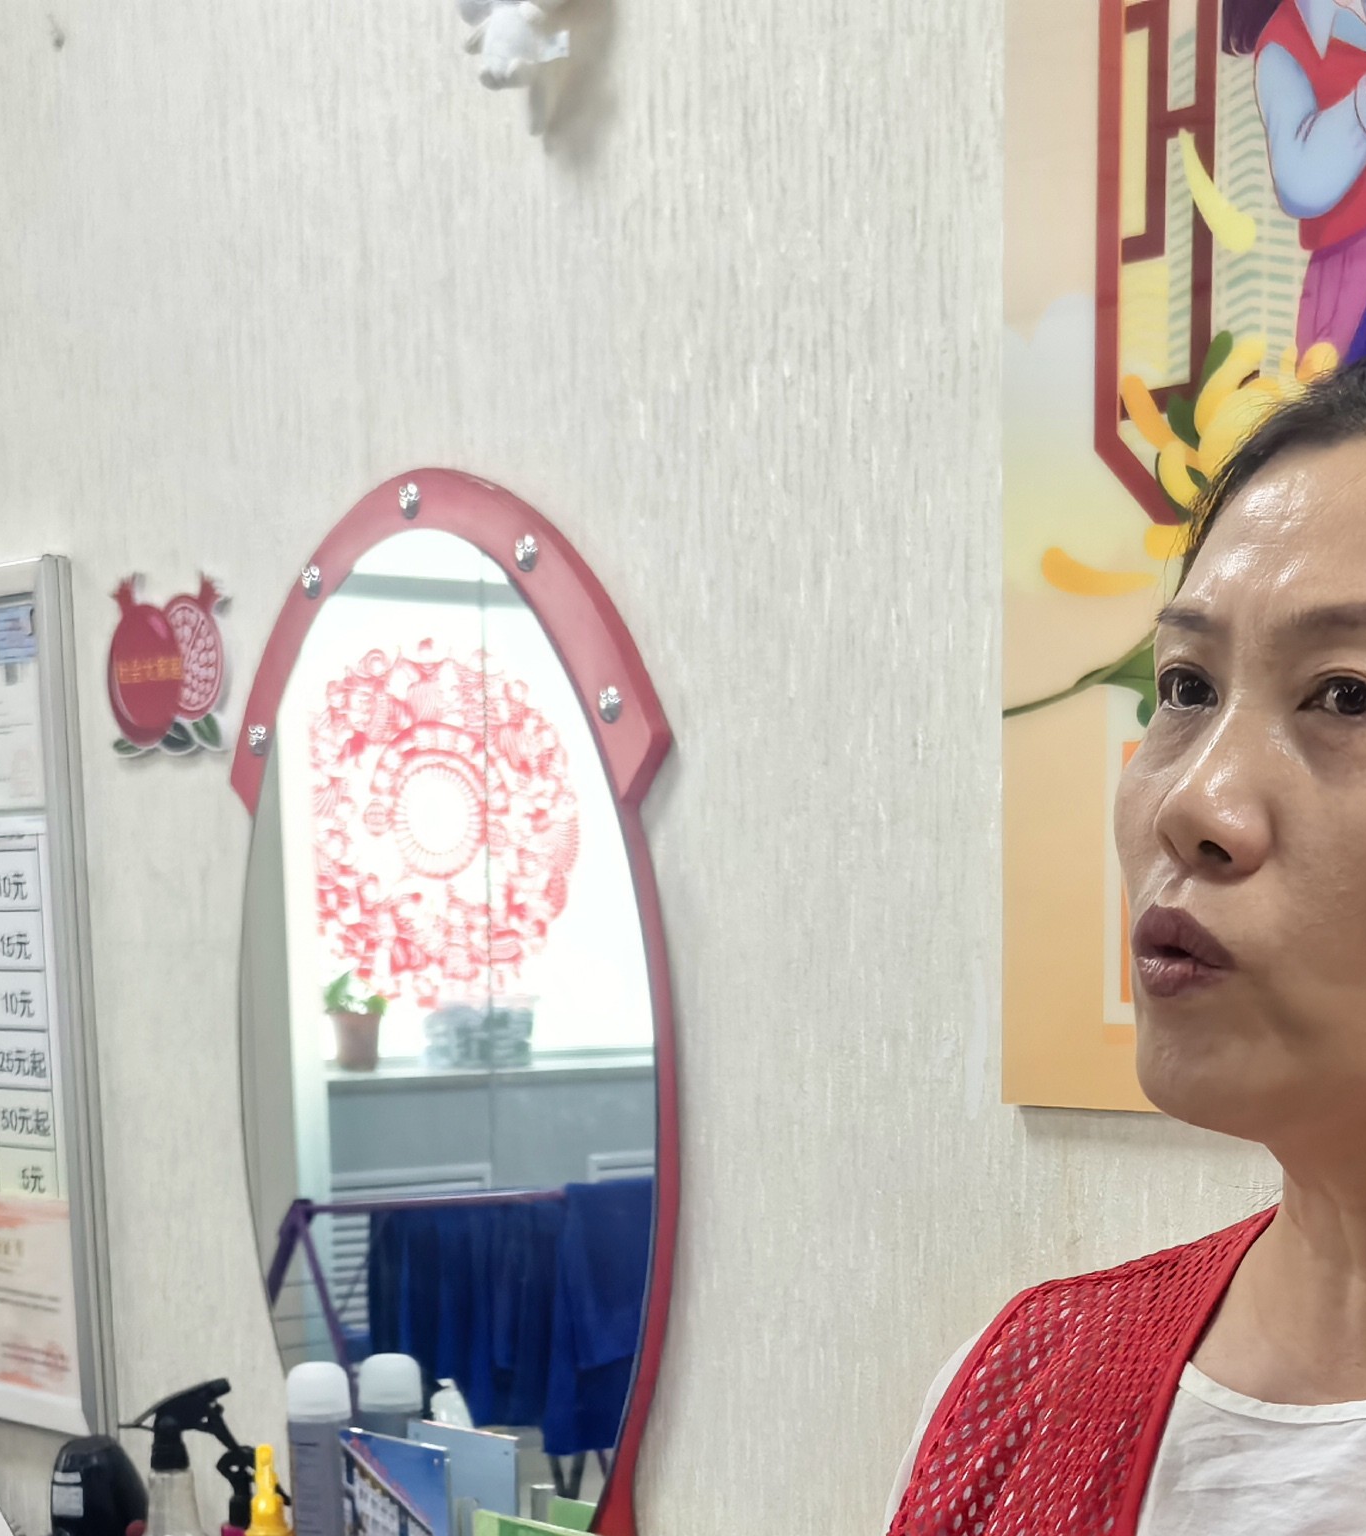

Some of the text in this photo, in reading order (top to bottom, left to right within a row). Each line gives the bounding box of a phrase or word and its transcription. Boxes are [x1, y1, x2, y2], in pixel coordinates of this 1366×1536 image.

[0, 931, 33, 960] 15元
[2, 989, 36, 1018] 10元
[0, 1106, 52, 1138] 50元起
[20, 1166, 47, 1195] 5元
